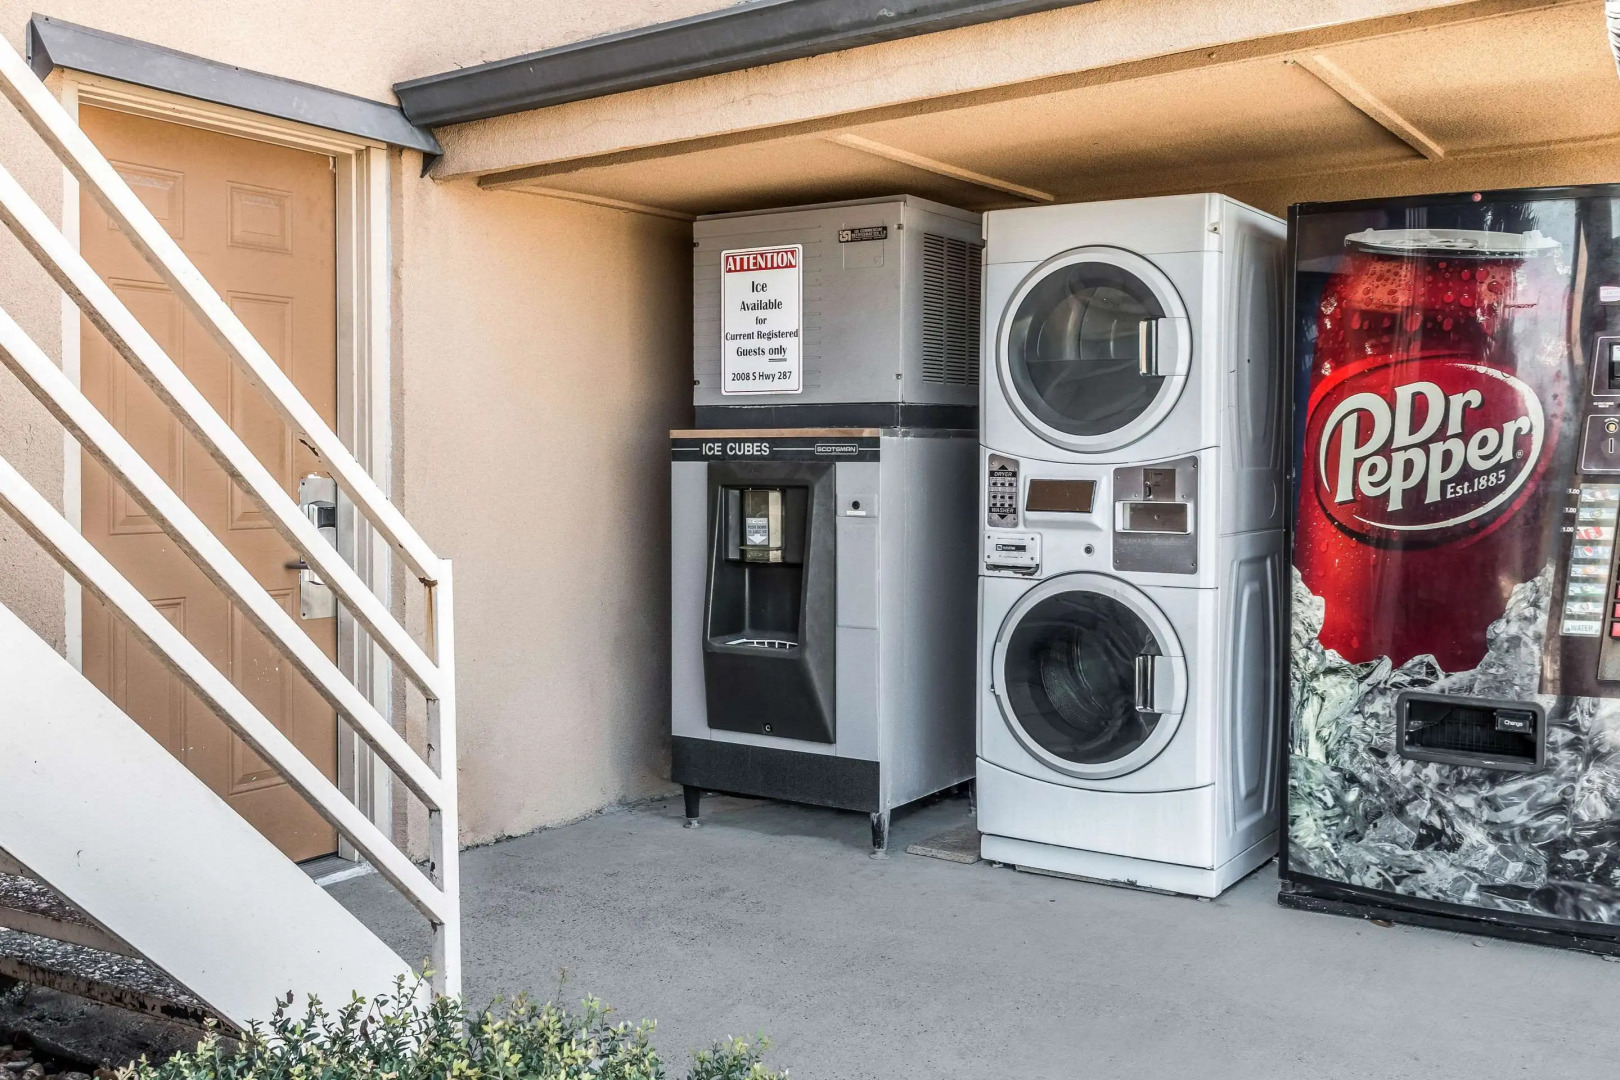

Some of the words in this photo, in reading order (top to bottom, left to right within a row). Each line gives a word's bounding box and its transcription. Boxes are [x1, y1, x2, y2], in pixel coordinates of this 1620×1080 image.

[726, 250, 796, 272] ATTENTION
[751, 280, 768, 293] Ice
[740, 298, 783, 312] Available
[755, 316, 768, 325] for
[725, 330, 755, 341] Current
[757, 328, 799, 341] Registered
[736, 346, 766, 357] Guests
[768, 345, 787, 357] only
[731, 372, 751, 382] 2008
[752, 371, 757, 381] S
[758, 371, 776, 382] Hwy
[778, 370, 792, 380] 287
[1391, 381, 1482, 449] Dr
[702, 442, 722, 456] ICE
[726, 442, 770, 456] CUBES
[1320, 392, 1532, 512] Pepper
[1570, 624, 1594, 632] WATER
[1504, 719, 1523, 727] Change
